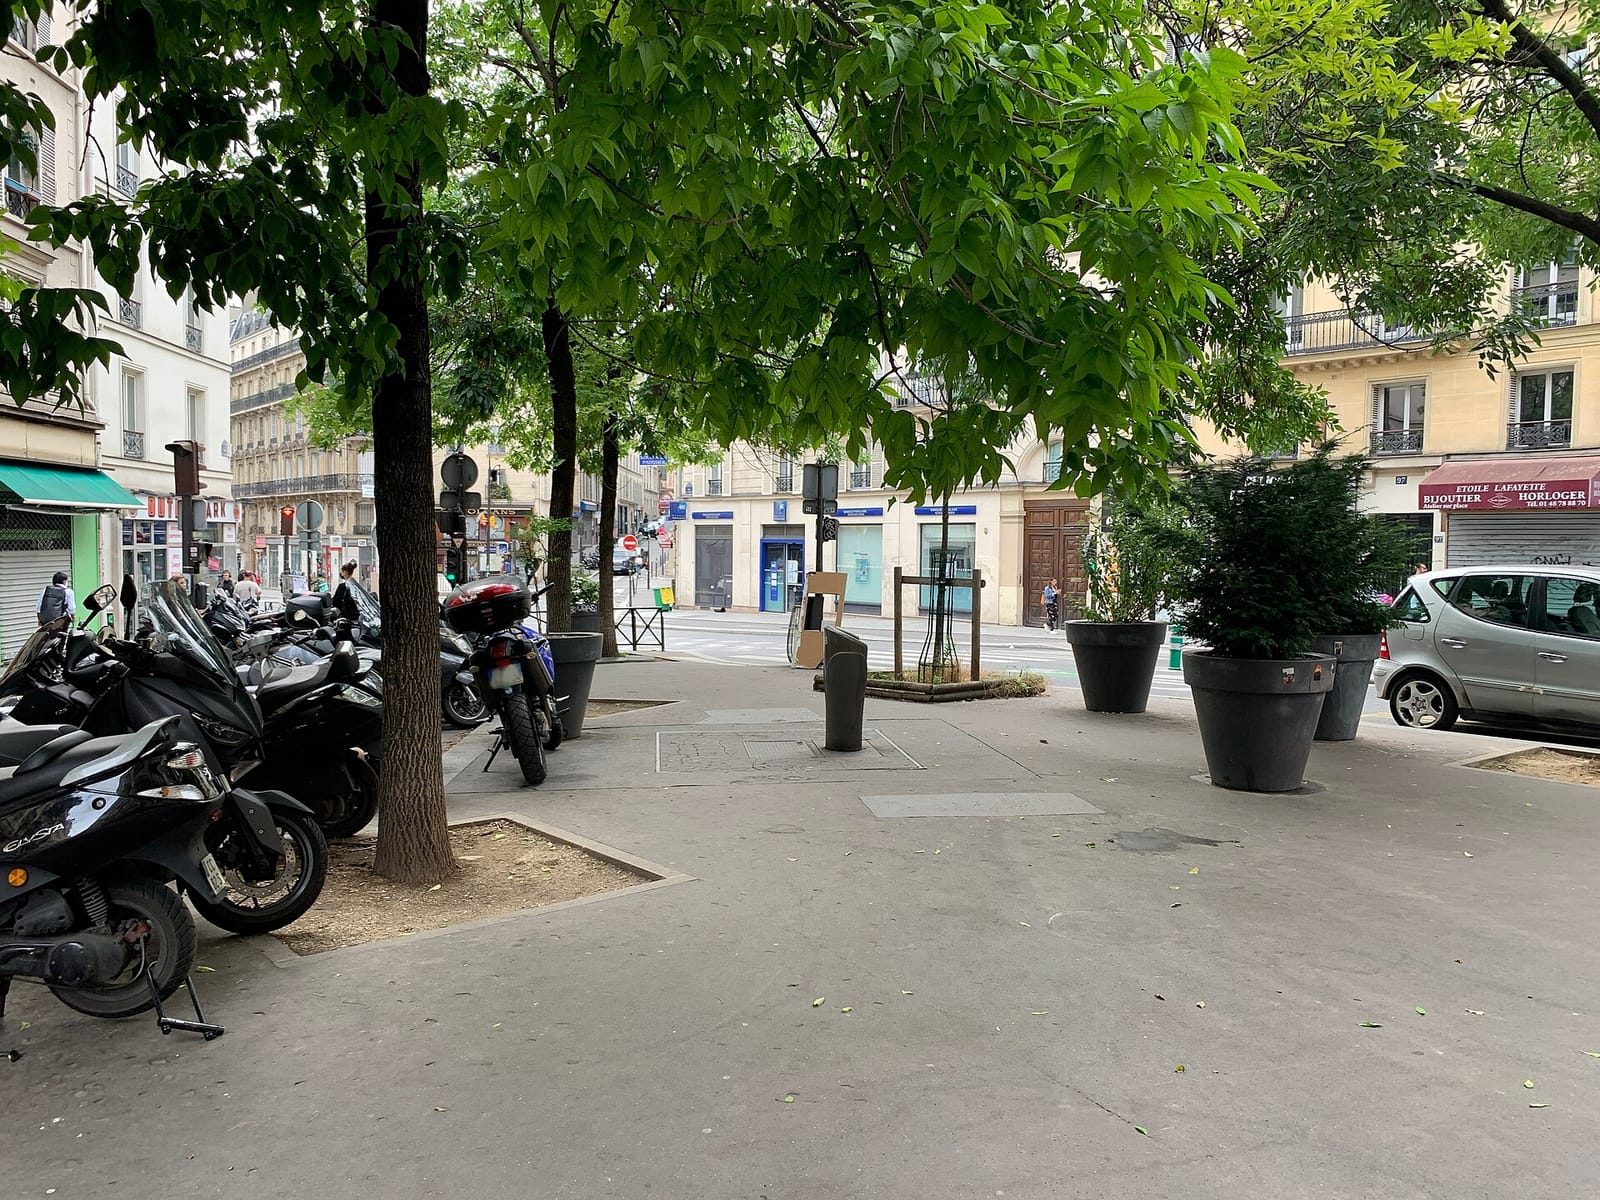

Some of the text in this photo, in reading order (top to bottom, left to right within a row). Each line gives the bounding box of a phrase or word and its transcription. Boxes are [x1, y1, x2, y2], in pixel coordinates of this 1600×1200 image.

[1456, 482, 1546, 493] ETOILE LAFAYETTE
[1423, 494, 1482, 504] BIJOUTIER
[1518, 491, 1586, 501] HORLOGER
[206, 500, 226, 519] ARK
[1452, 502, 1468, 510] place
